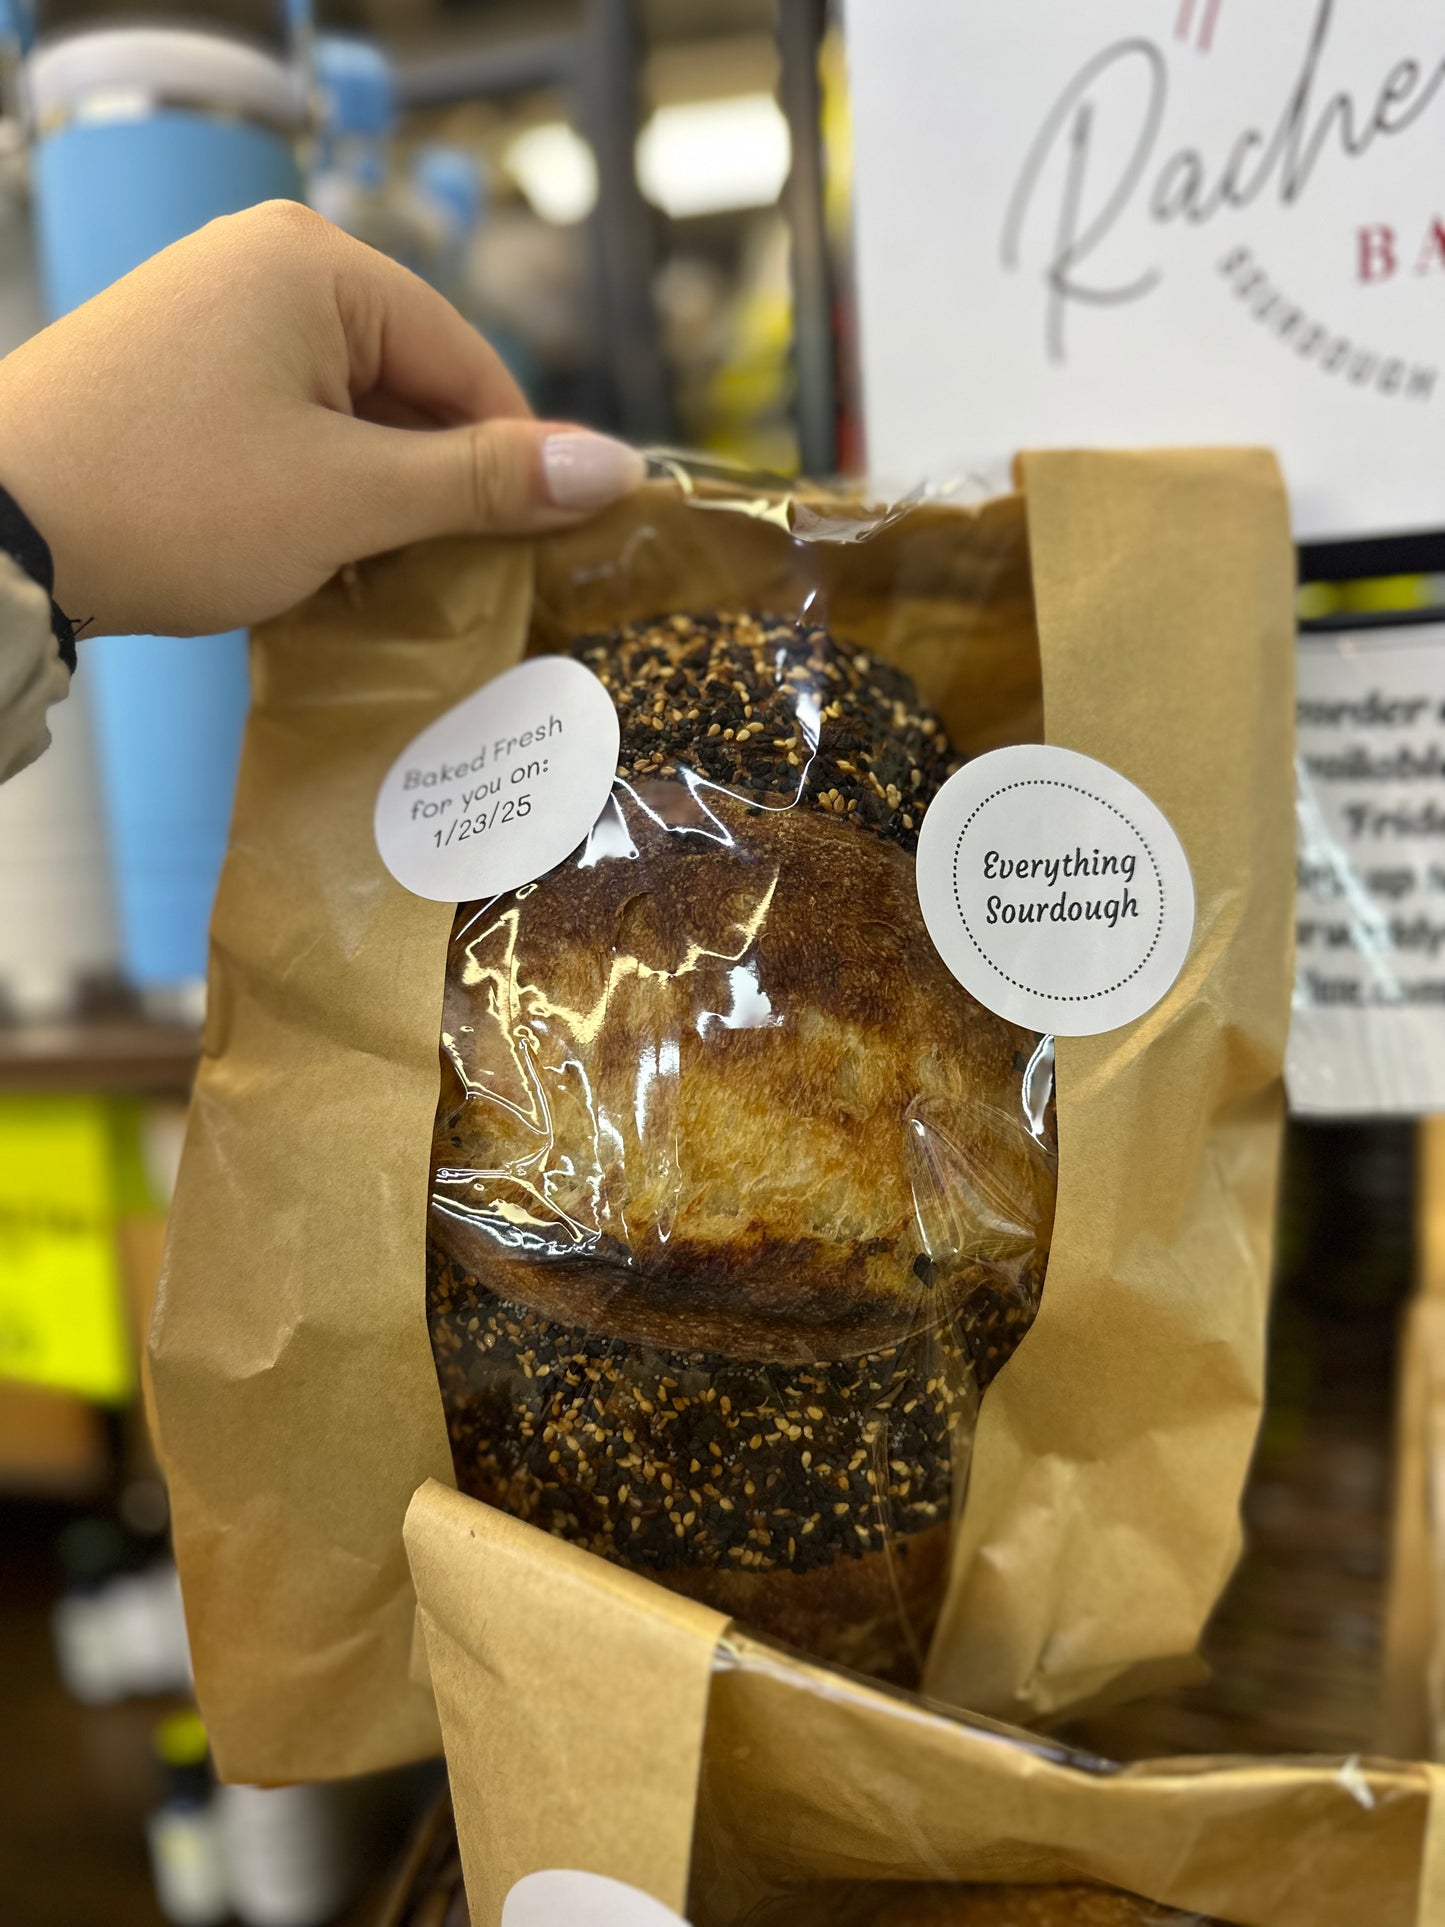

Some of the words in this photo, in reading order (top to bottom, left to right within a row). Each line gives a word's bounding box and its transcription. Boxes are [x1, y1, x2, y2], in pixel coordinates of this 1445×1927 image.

[403, 744, 487, 792] Baked
[493, 714, 563, 762] Fresh
[411, 799, 453, 821] for
[462, 777, 501, 813] you
[510, 759, 549, 785] on:
[432, 794, 532, 848] 1/23/25
[983, 847, 1136, 887] Everything
[986, 887, 1139, 928] Sourdough
